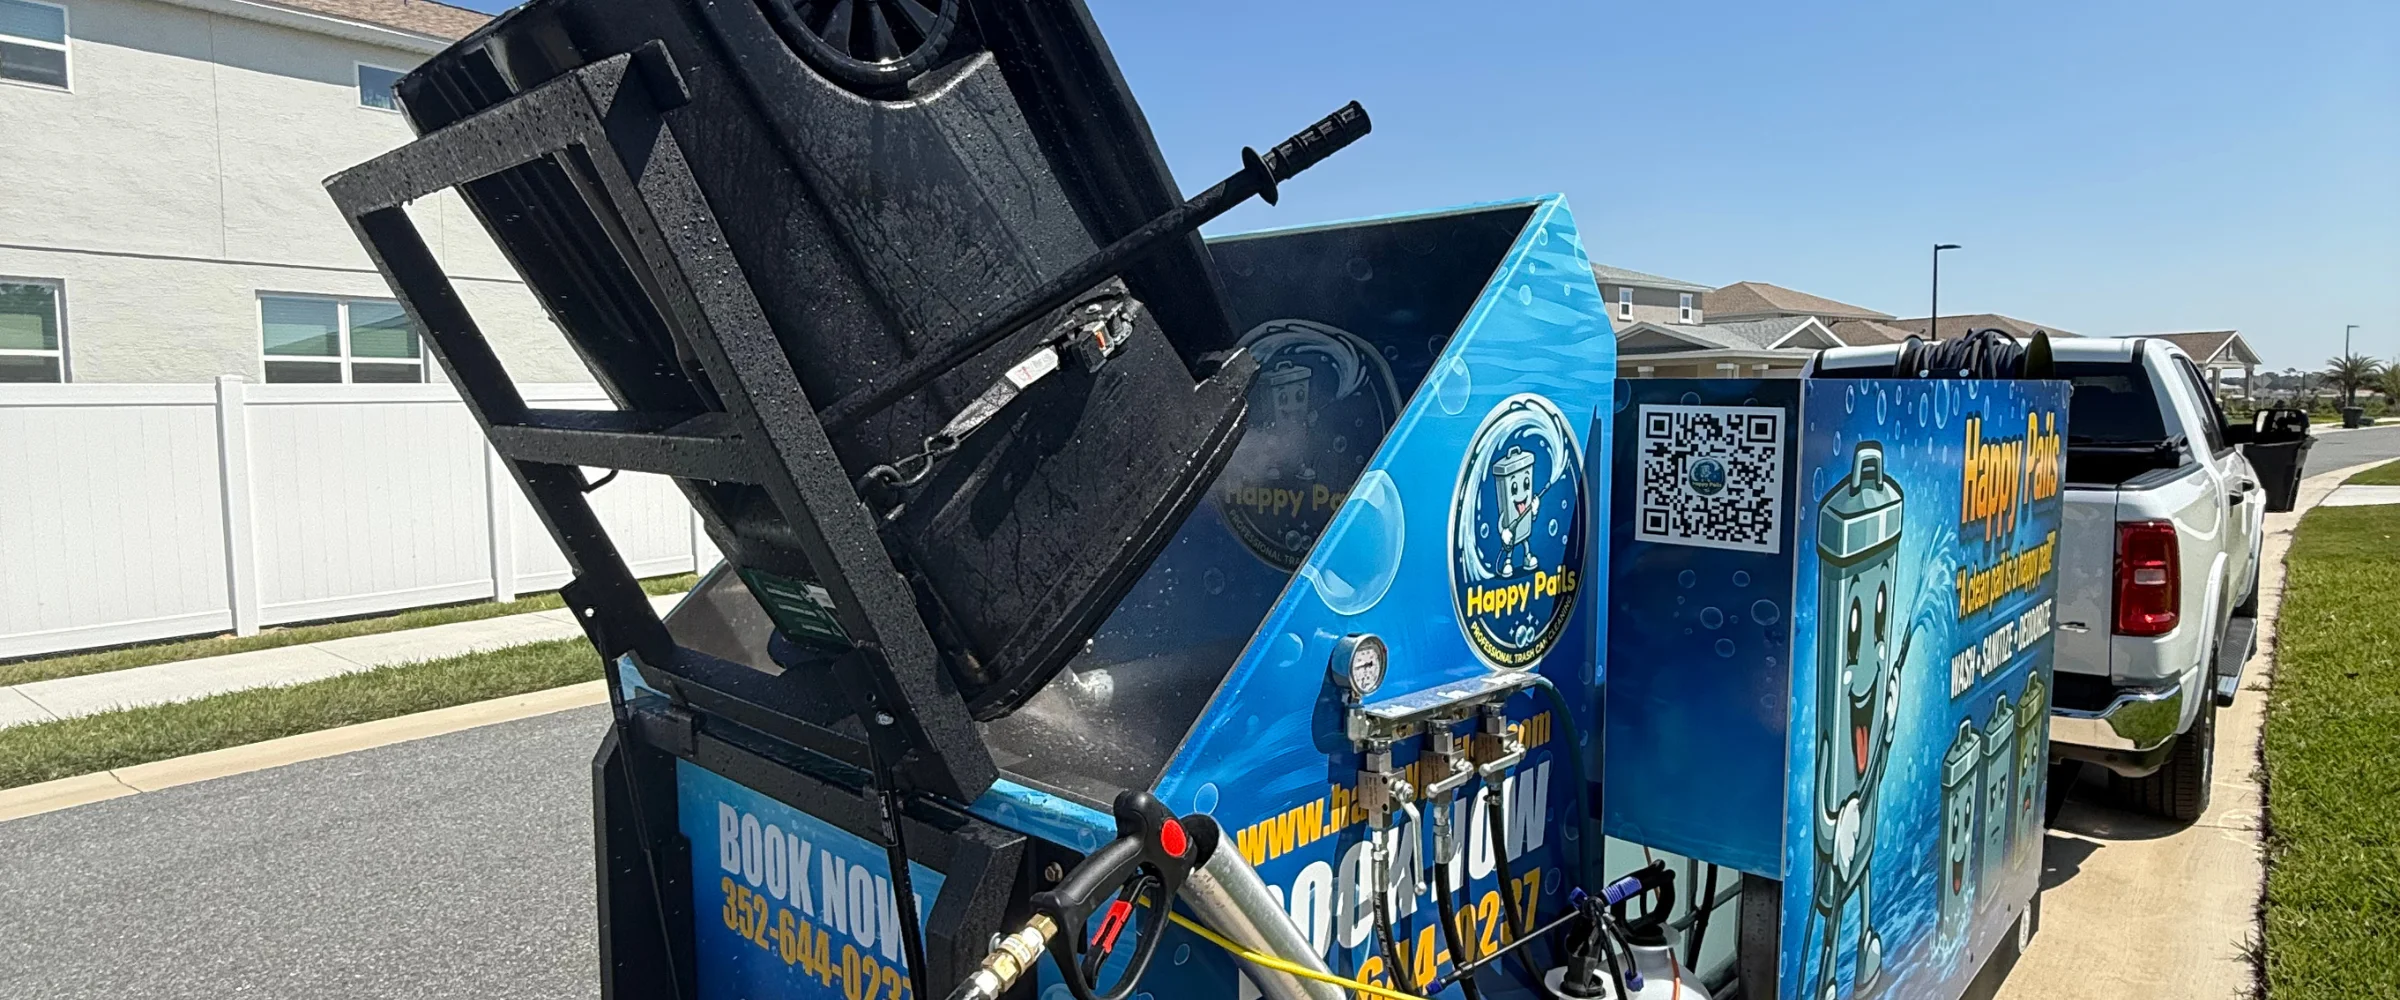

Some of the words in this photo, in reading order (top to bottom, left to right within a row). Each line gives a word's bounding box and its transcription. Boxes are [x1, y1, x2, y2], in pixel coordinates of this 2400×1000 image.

[1223, 481, 1305, 518] Happy
[1962, 416, 2023, 542] Happy
[2024, 411, 2060, 505] Pails
[1229, 509, 1281, 560] PROFESSIONAL
[1466, 581, 1531, 619] Happy
[1534, 565, 1577, 600] Pails
[1968, 564, 1990, 615] clean
[1989, 551, 2006, 613] pail
[2005, 551, 2012, 594] is
[2012, 557, 2018, 590] a
[2018, 544, 2039, 593] happy
[1470, 620, 1514, 664] PROFESSIONAL
[1514, 650, 1535, 664] TRASH
[1535, 638, 1548, 656] CAN
[1547, 595, 1573, 641] CLEANING
[1951, 644, 1977, 700] WASH
[1981, 620, 2015, 678] SANITIZE
[2017, 598, 2052, 652] DEODORIZE
[718, 801, 815, 917] BOOK
[821, 848, 923, 969] NOW
[1238, 821, 1421, 1000] OOK
[721, 876, 914, 1000] 352-644-023
